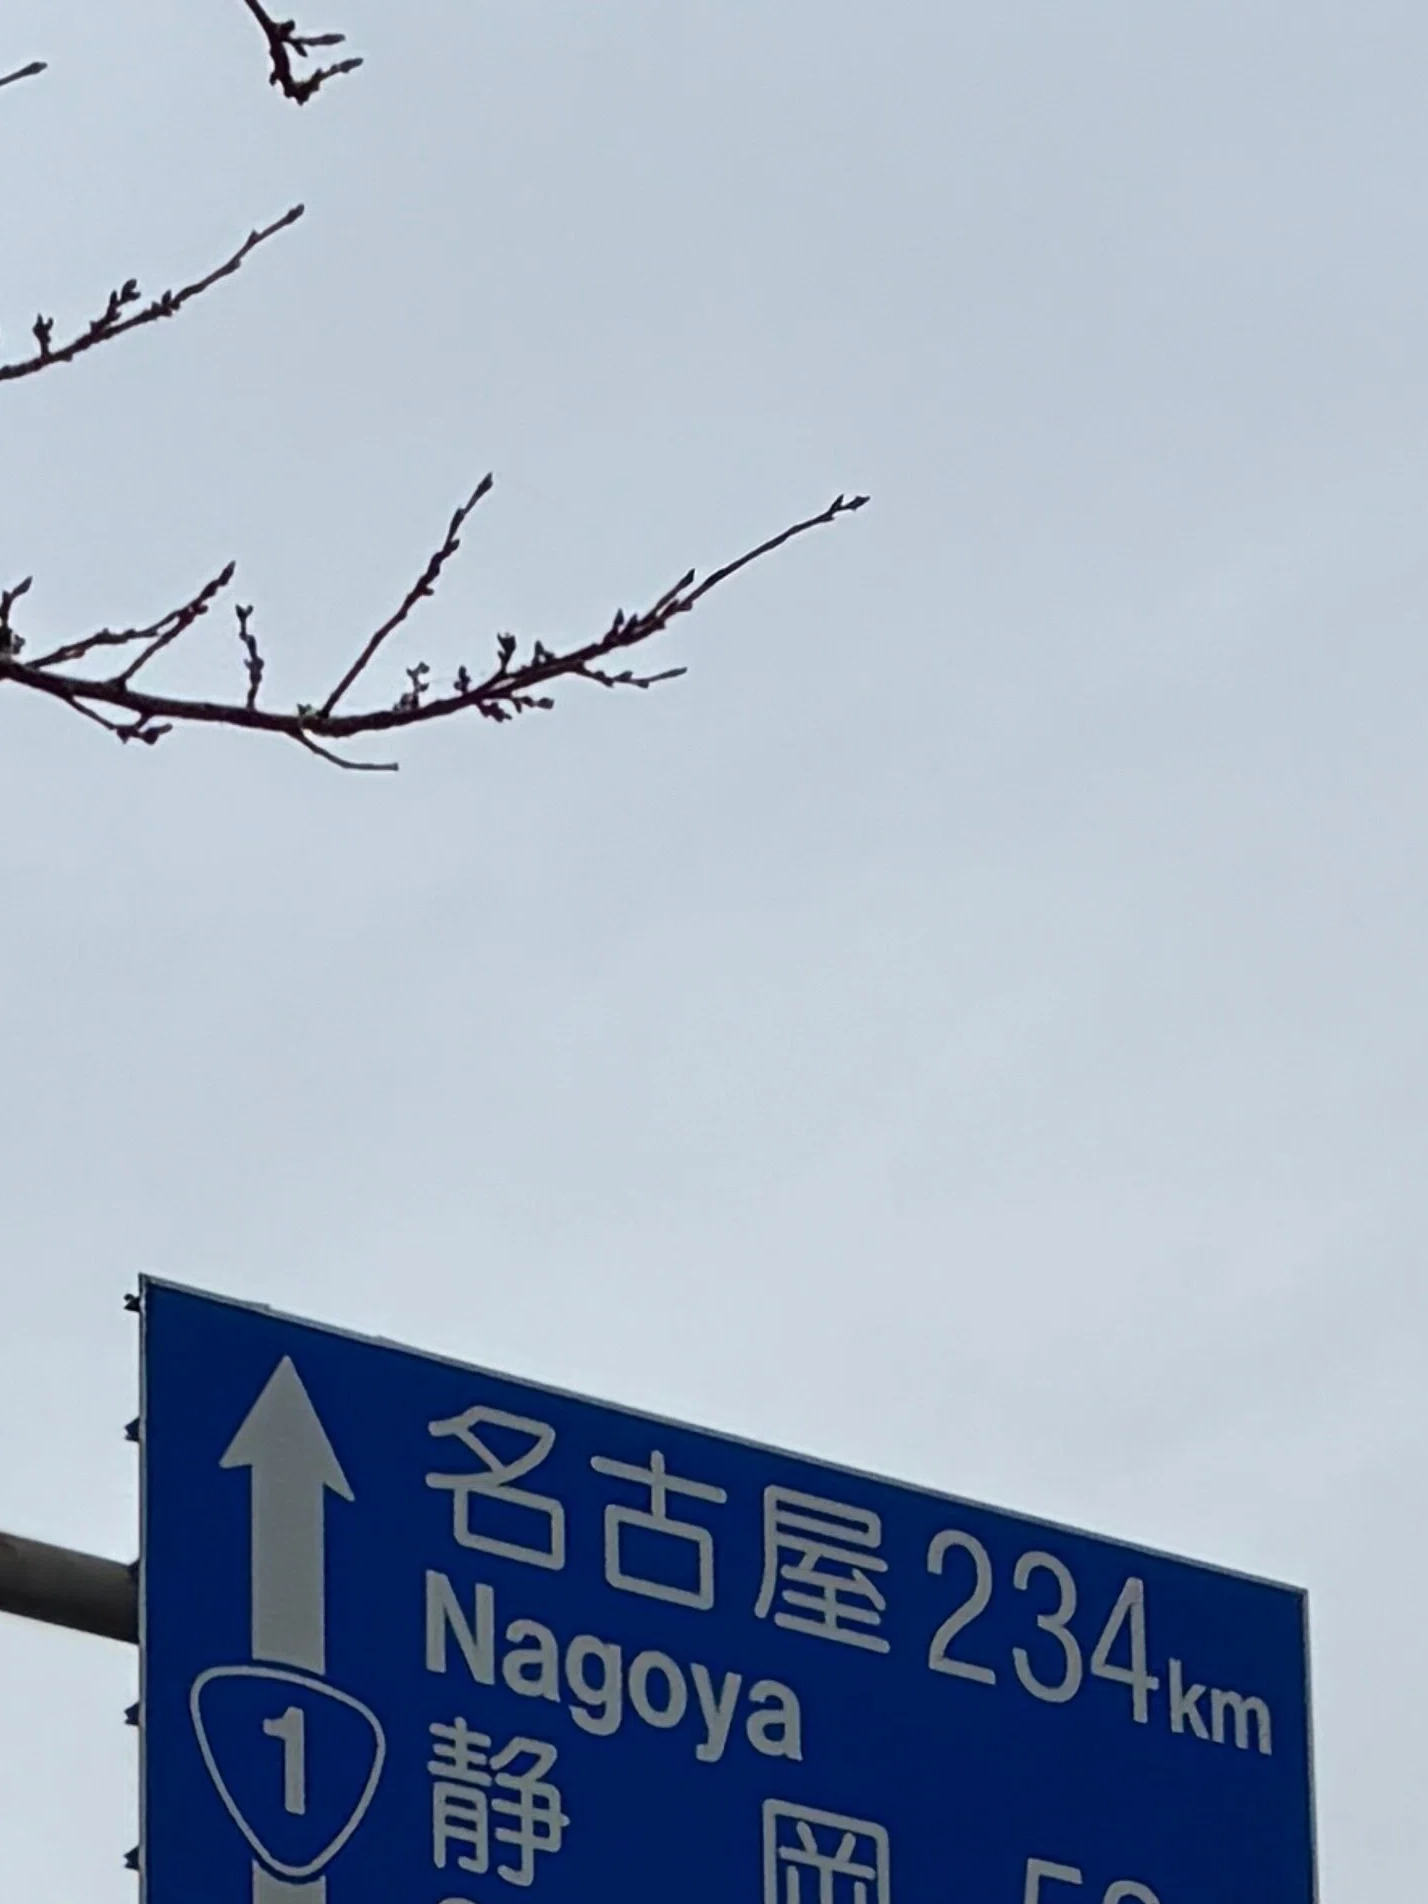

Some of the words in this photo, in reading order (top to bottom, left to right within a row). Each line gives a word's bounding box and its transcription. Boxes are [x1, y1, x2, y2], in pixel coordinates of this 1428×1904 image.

[425, 1405, 891, 1654] 名古屋
[263, 1706, 306, 1815] 1
[425, 1569, 803, 1762] Nagoya
